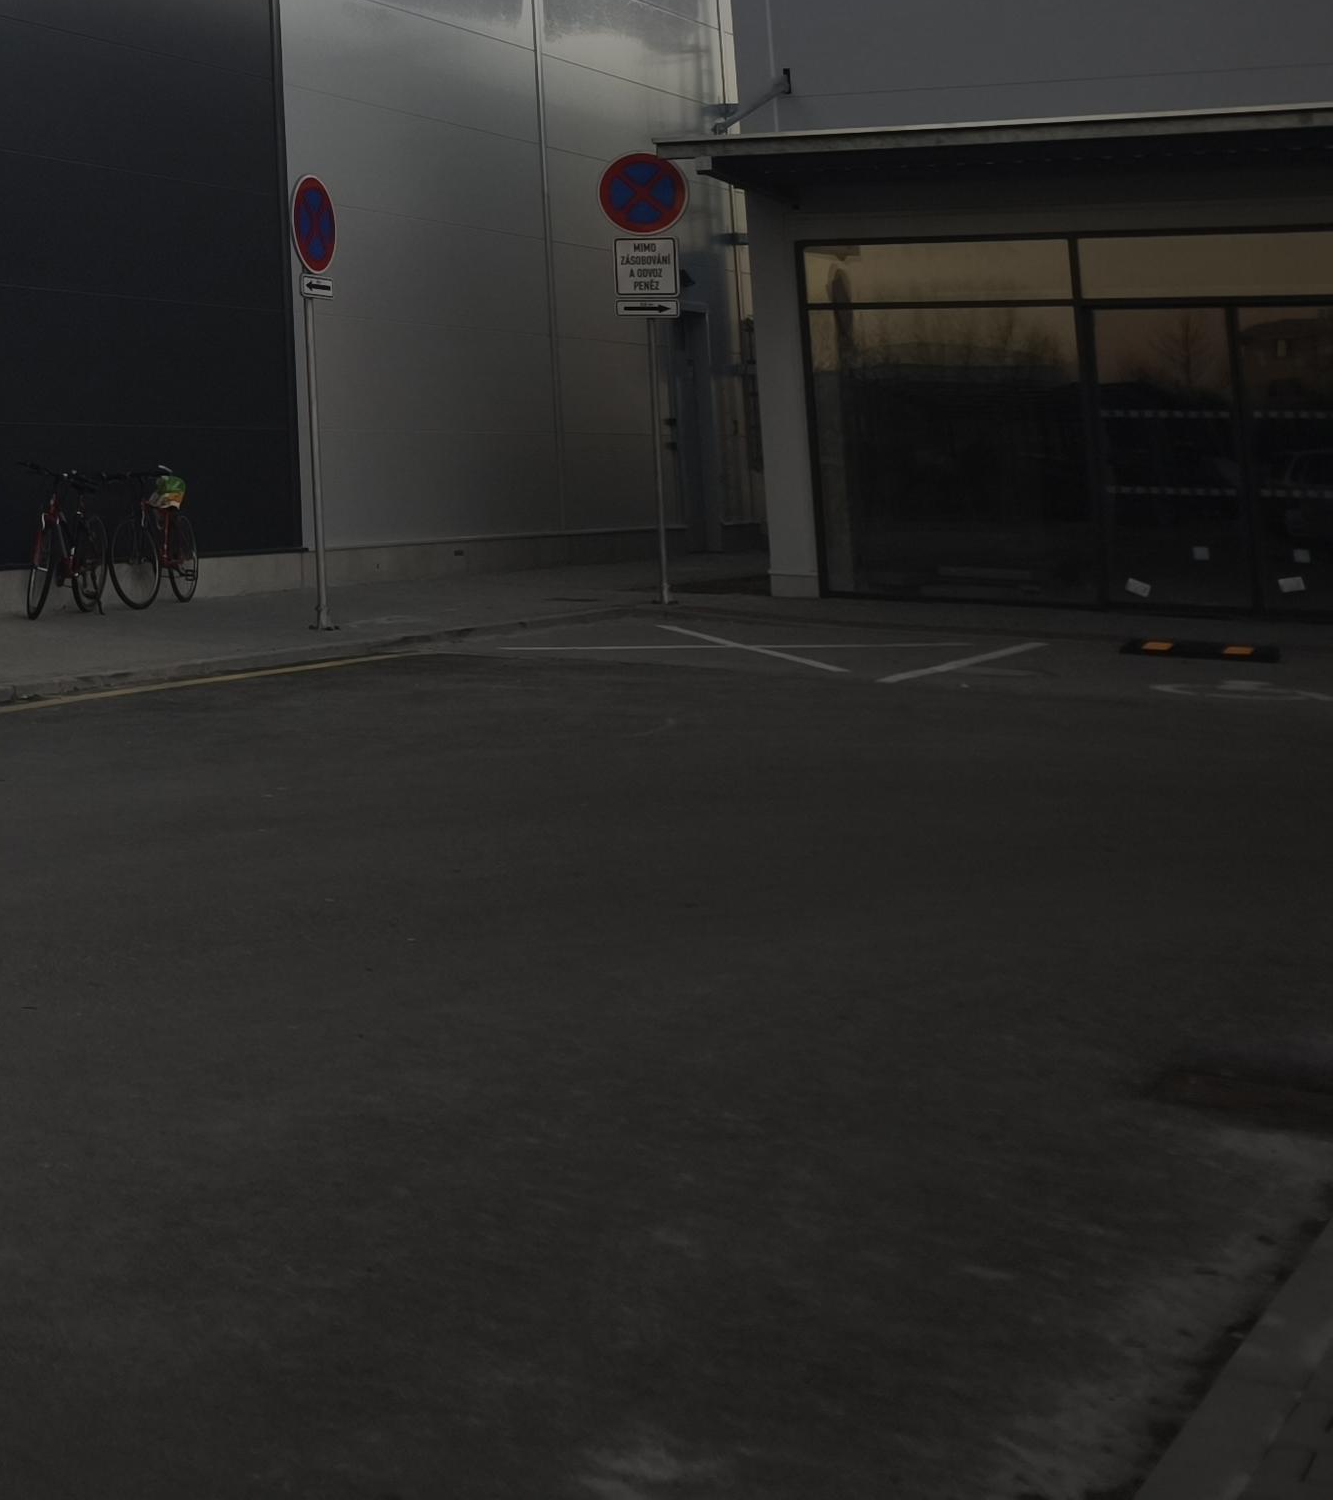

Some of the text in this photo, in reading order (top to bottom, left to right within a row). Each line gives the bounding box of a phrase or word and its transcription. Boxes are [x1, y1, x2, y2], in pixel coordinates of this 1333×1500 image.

[633, 243, 656, 252] MIMO
[620, 254, 670, 265] ZÁSOBOVÁNÍ
[629, 268, 663, 278] A ODVOZ
